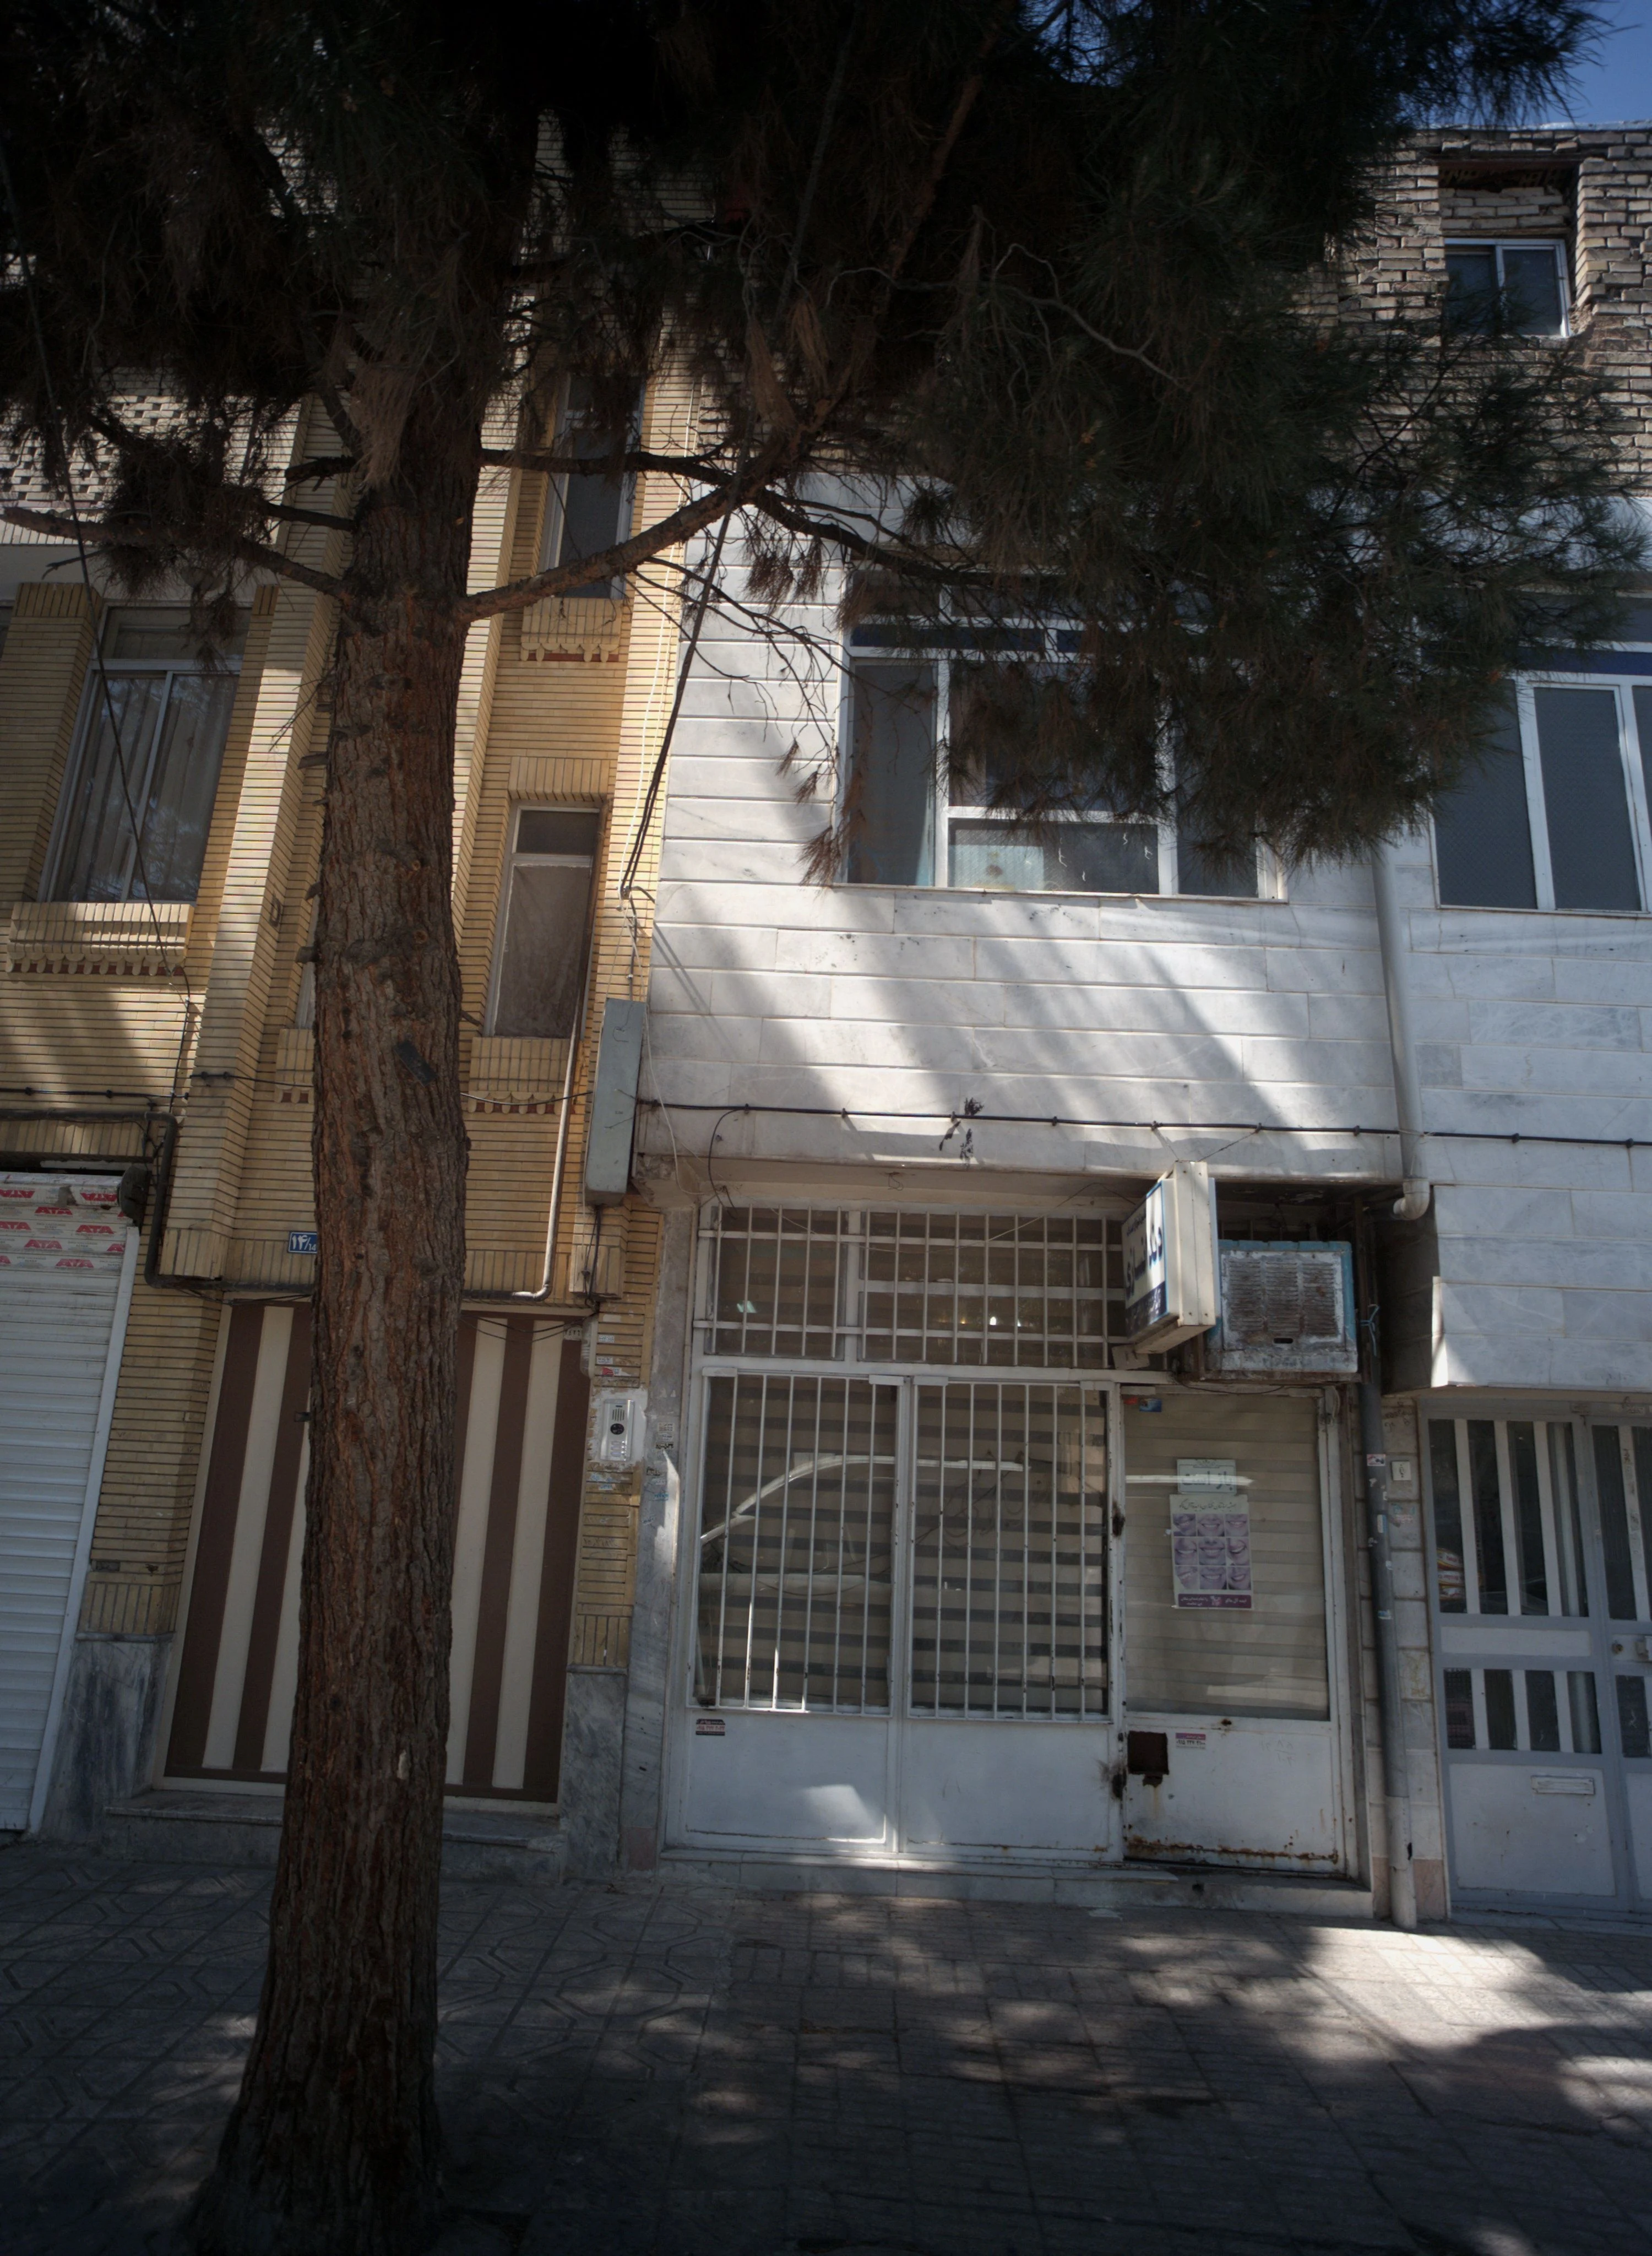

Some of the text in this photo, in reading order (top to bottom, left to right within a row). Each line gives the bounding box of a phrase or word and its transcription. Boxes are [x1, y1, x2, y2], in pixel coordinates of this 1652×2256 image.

[35, 1207, 72, 1215] ATA
[76, 1225, 114, 1234] ATA
[24, 1240, 62, 1249] ATA
[56, 1259, 93, 1267] ATA
